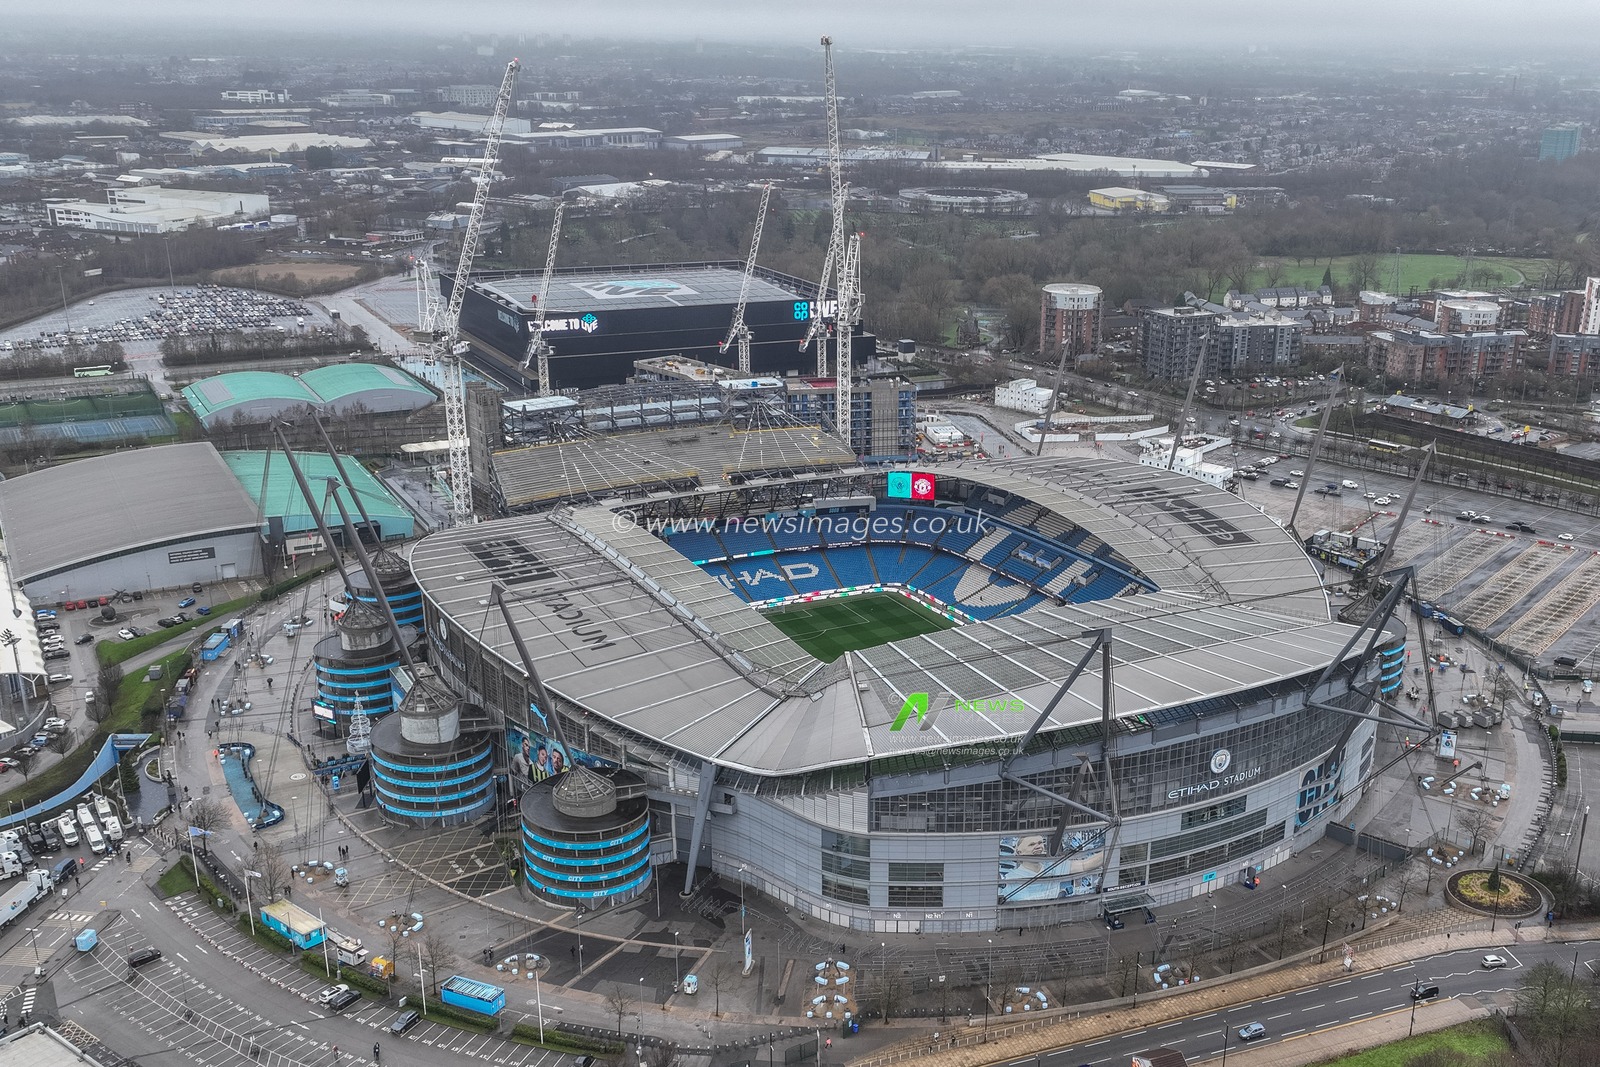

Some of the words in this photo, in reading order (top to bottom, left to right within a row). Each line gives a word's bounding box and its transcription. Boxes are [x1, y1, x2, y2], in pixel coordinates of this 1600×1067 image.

[712, 562, 820, 590] HAD
[1168, 780, 1220, 799] ETIHAD
[1224, 766, 1261, 786] STADIUM
[610, 837, 624, 846] CITY
[632, 845, 642, 854] CITY
[542, 854, 555, 863] CITY
